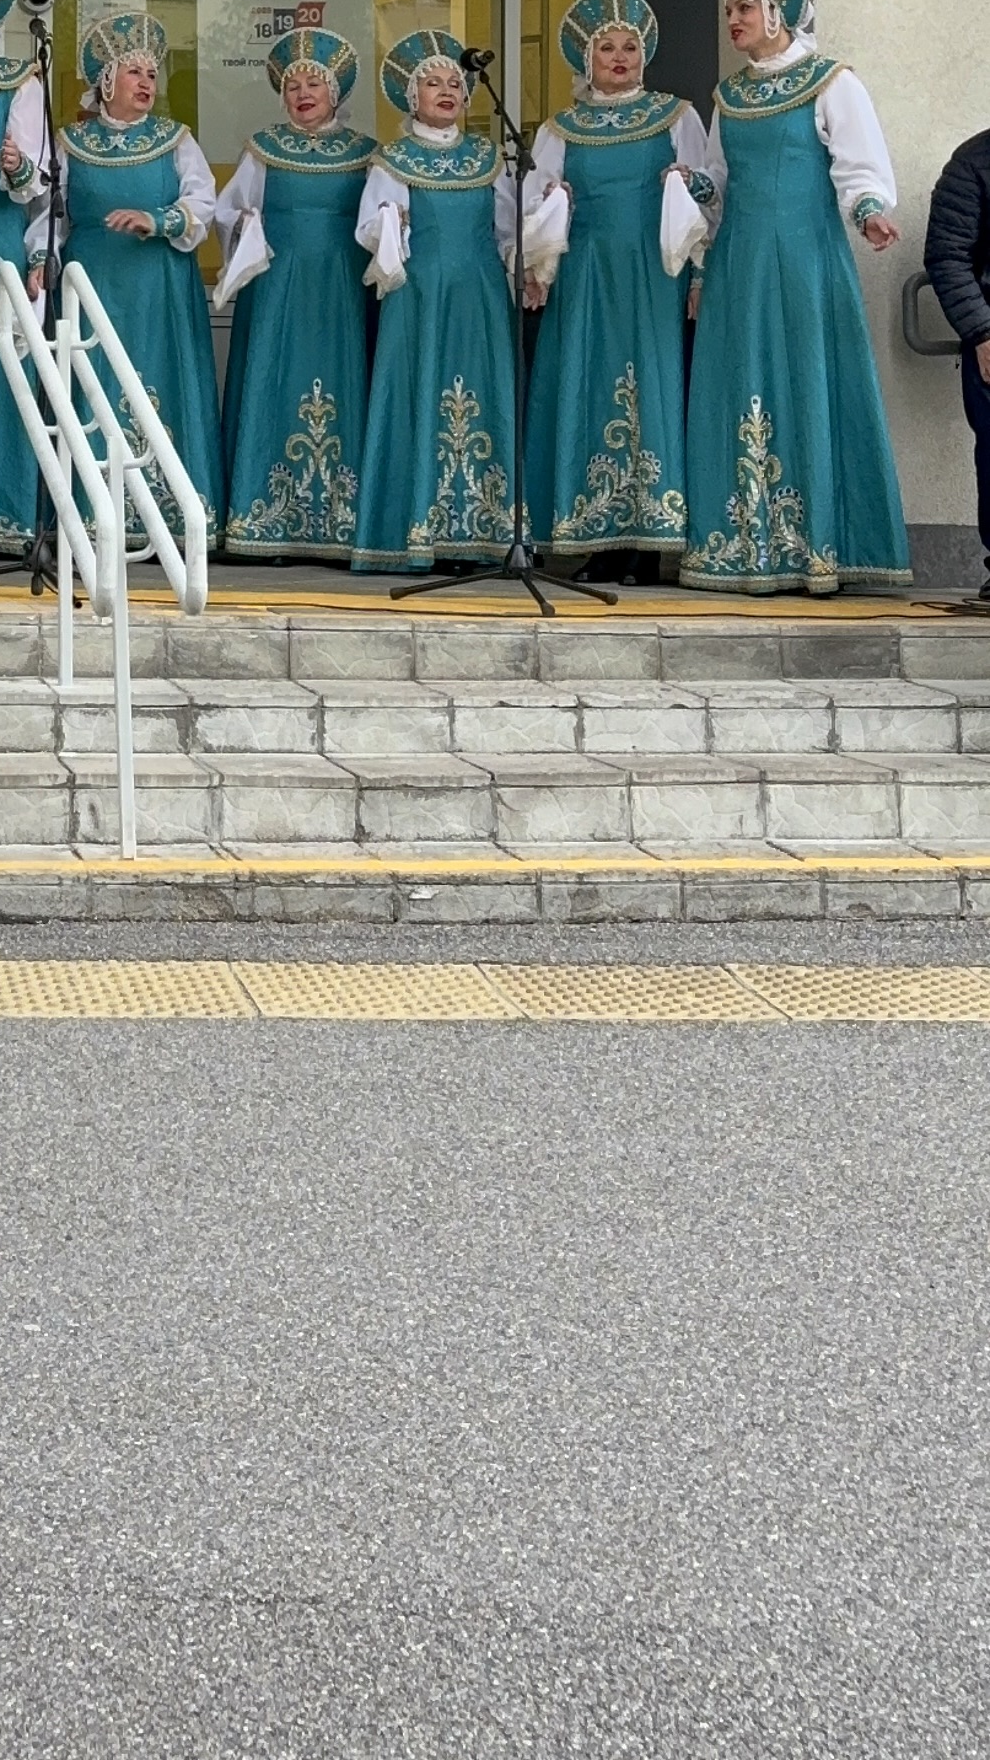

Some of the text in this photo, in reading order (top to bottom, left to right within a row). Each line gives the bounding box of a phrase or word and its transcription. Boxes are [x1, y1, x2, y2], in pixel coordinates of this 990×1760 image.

[276, 15, 294, 30] 19
[297, 9, 321, 23] 20
[254, 23, 272, 38] 18
[222, 58, 266, 67] ТВОЙ ГОЛ
